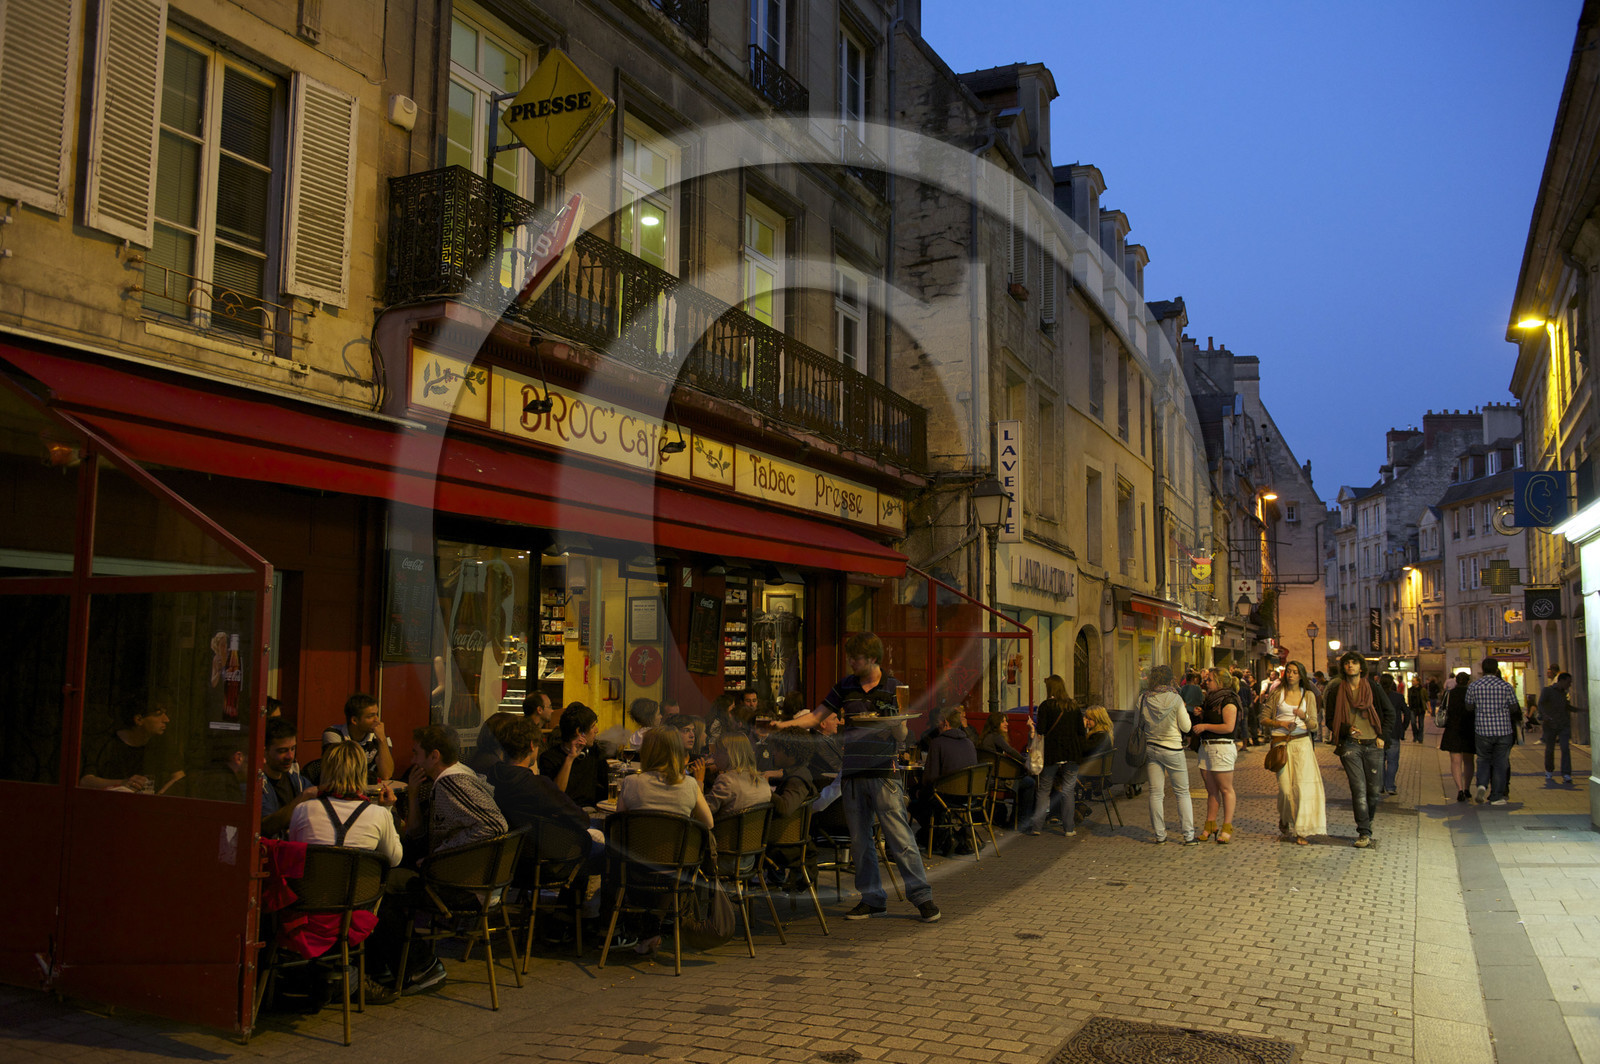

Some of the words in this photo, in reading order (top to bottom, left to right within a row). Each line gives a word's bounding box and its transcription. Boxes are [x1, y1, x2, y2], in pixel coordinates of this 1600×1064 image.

[509, 91, 592, 122] PRESSE
[618, 414, 671, 467] Café
[749, 454, 796, 496] Tabac
[814, 473, 863, 518] Presse
